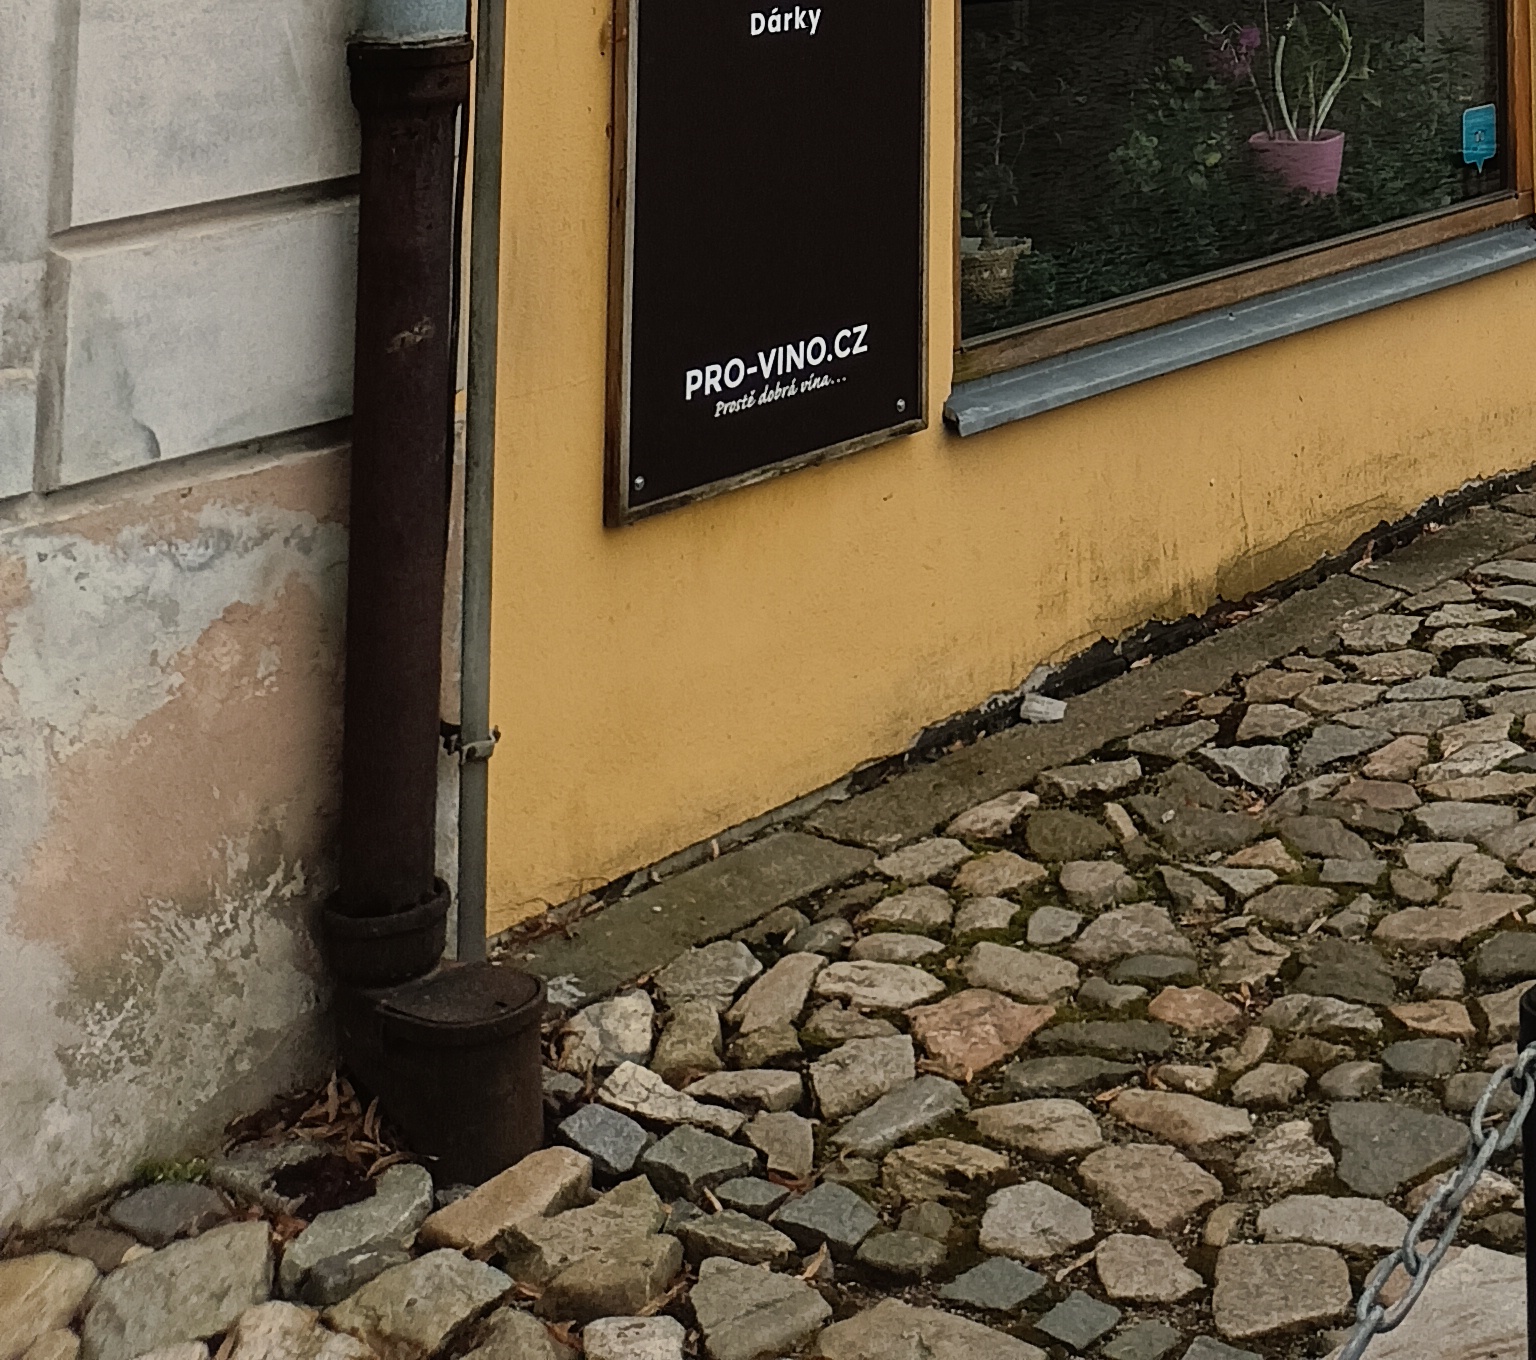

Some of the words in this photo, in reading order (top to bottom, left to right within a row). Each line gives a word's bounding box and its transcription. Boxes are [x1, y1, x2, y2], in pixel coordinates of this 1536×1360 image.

[750, 6, 821, 36] Dárky
[685, 324, 868, 401] PRO-VINO.CZ
[714, 389, 757, 418] Prostě
[757, 378, 798, 406] dobrá
